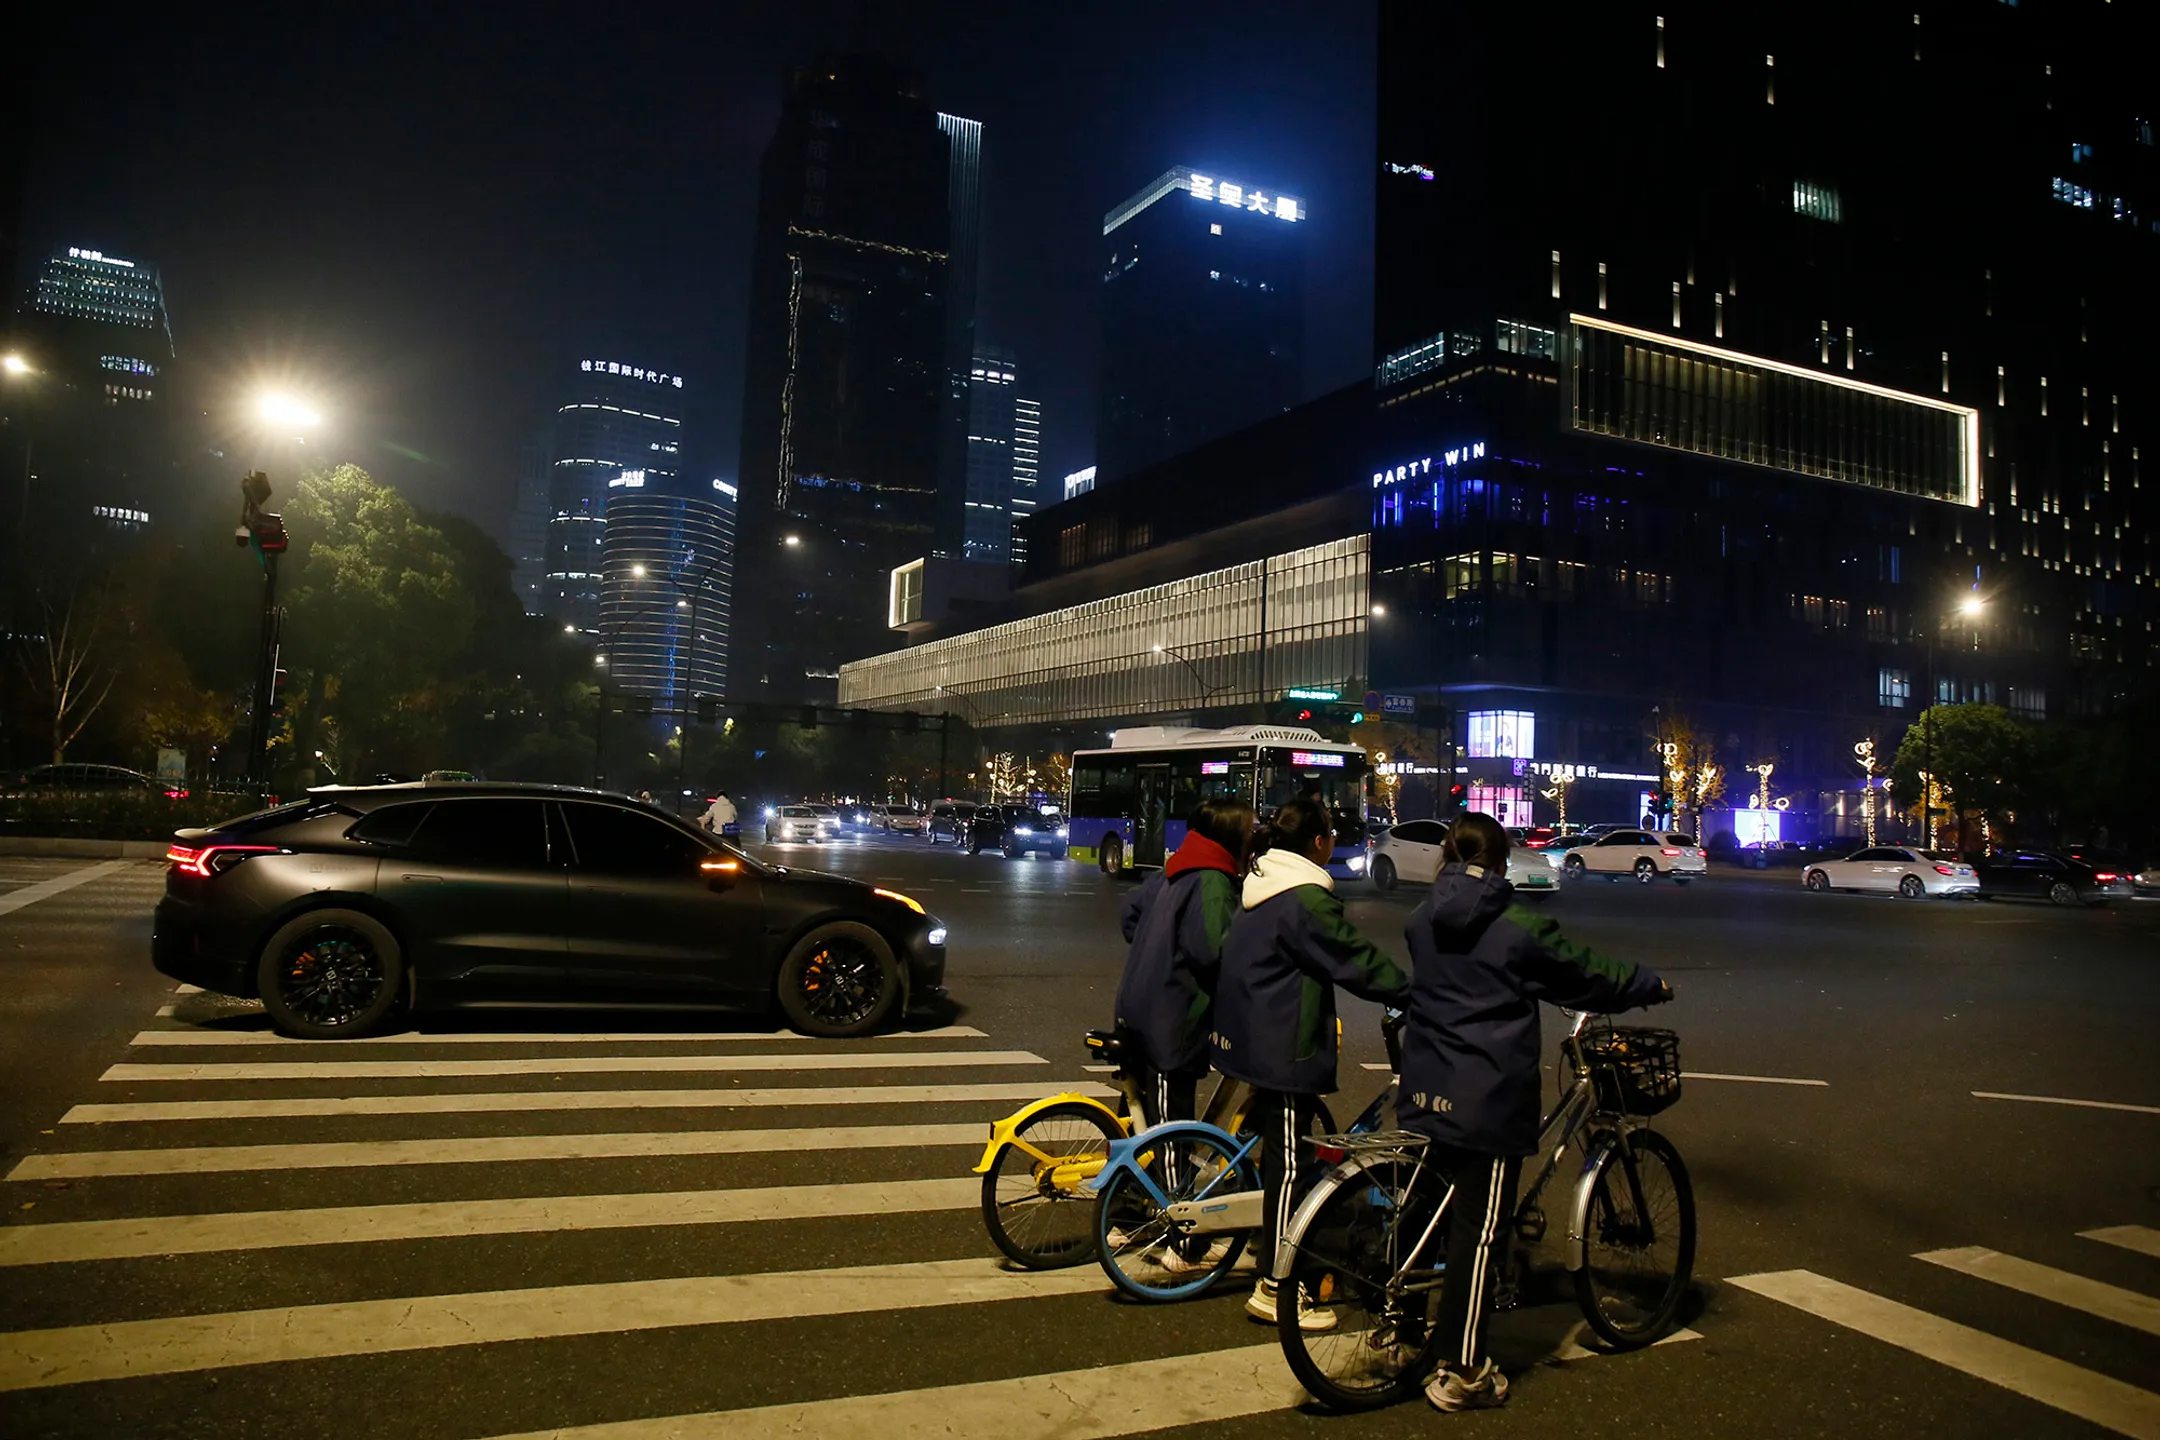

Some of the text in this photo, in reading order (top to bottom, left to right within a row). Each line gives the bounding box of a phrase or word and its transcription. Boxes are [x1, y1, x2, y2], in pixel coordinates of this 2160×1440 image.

[580, 359, 683, 389] 钱江国际时代广场
[1373, 441, 1485, 488] PARTY WIN
